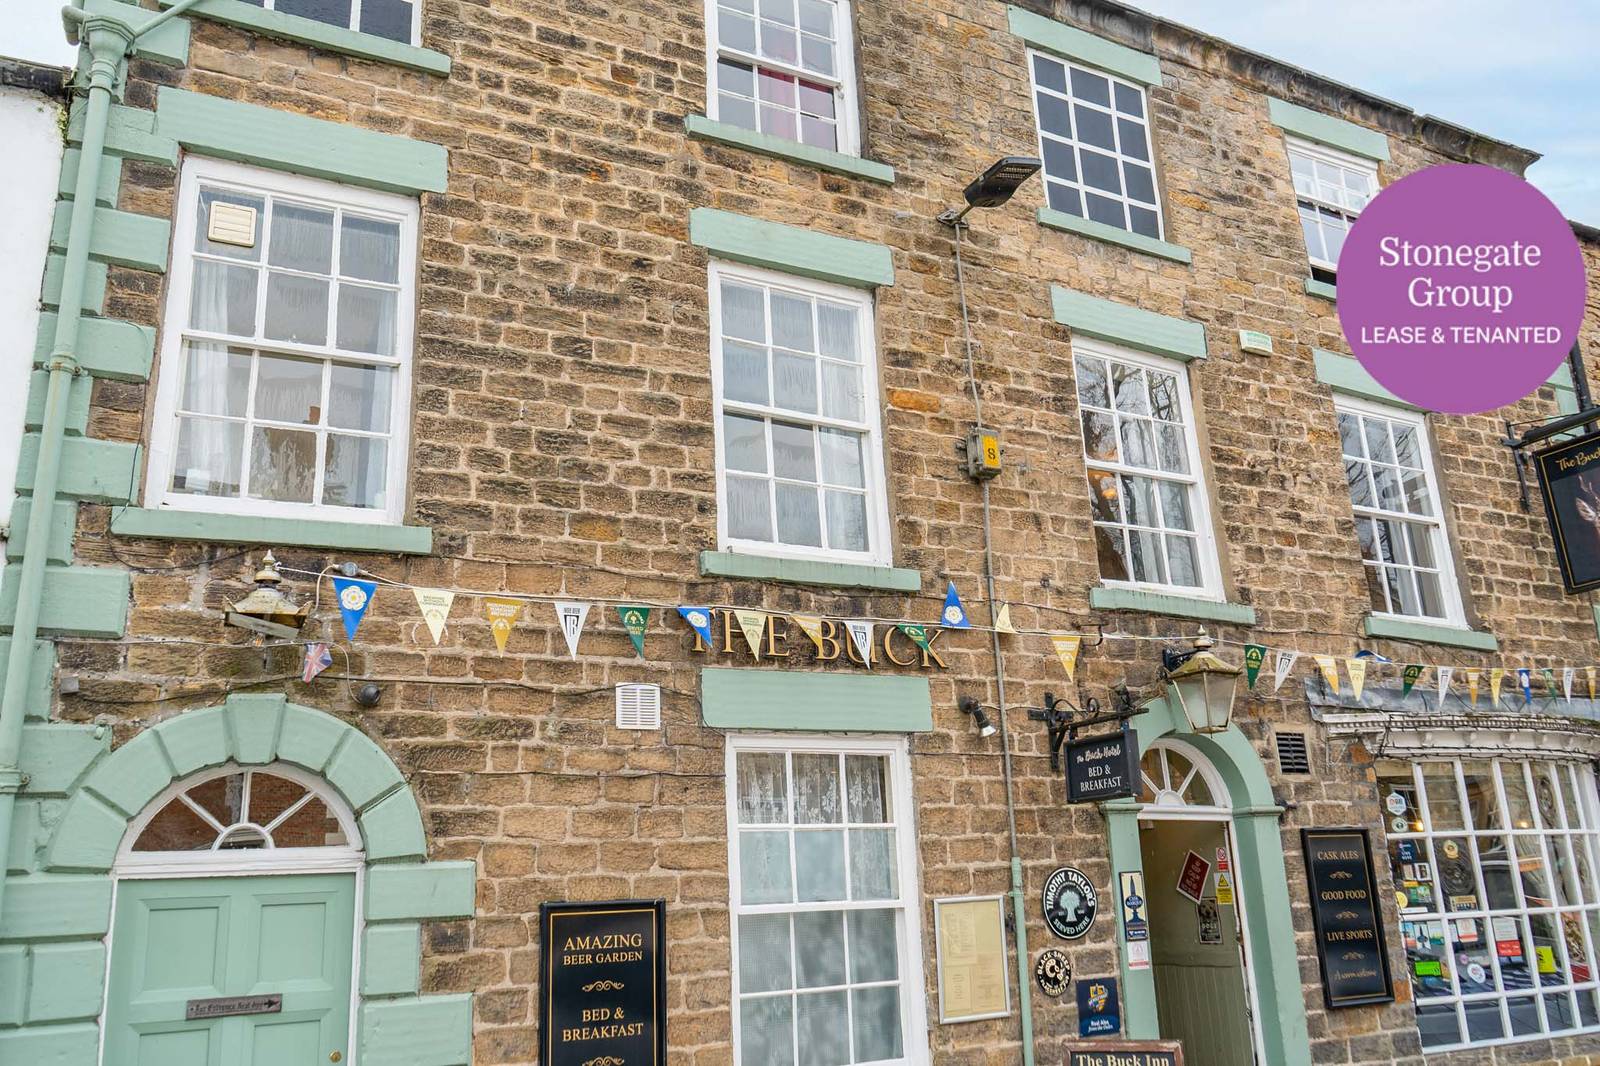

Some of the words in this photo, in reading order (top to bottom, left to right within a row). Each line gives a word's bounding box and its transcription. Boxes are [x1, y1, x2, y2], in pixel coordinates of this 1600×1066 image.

[1555, 457, 1576, 471] The
[816, 620, 949, 668] BUCK
[1088, 766, 1102, 777] BED
[1104, 764, 1111, 775] &
[1080, 776, 1121, 791] BREAKFAST
[1317, 850, 1338, 860] CASK
[1340, 849, 1359, 860] ALES
[1046, 872, 1066, 910] TIMOTHY
[1321, 892, 1344, 901] GOOD
[1345, 890, 1367, 900] FOOD
[1053, 918, 1076, 935] SERVED
[1075, 916, 1090, 933] HERE
[564, 933, 642, 951] AMAZING
[1327, 931, 1345, 942] LIVE
[1346, 929, 1373, 941] SPORTS
[563, 954, 593, 966] BEER
[595, 951, 643, 964] GARDEN
[1037, 951, 1051, 975] BLACK
[1053, 950, 1070, 970] SHEEP
[582, 1008, 610, 1022] BED
[613, 1006, 624, 1020] &
[562, 1022, 643, 1042] BREAKFAST
[1076, 1054, 1103, 1066] The
[1106, 1053, 1140, 1066] Buck
